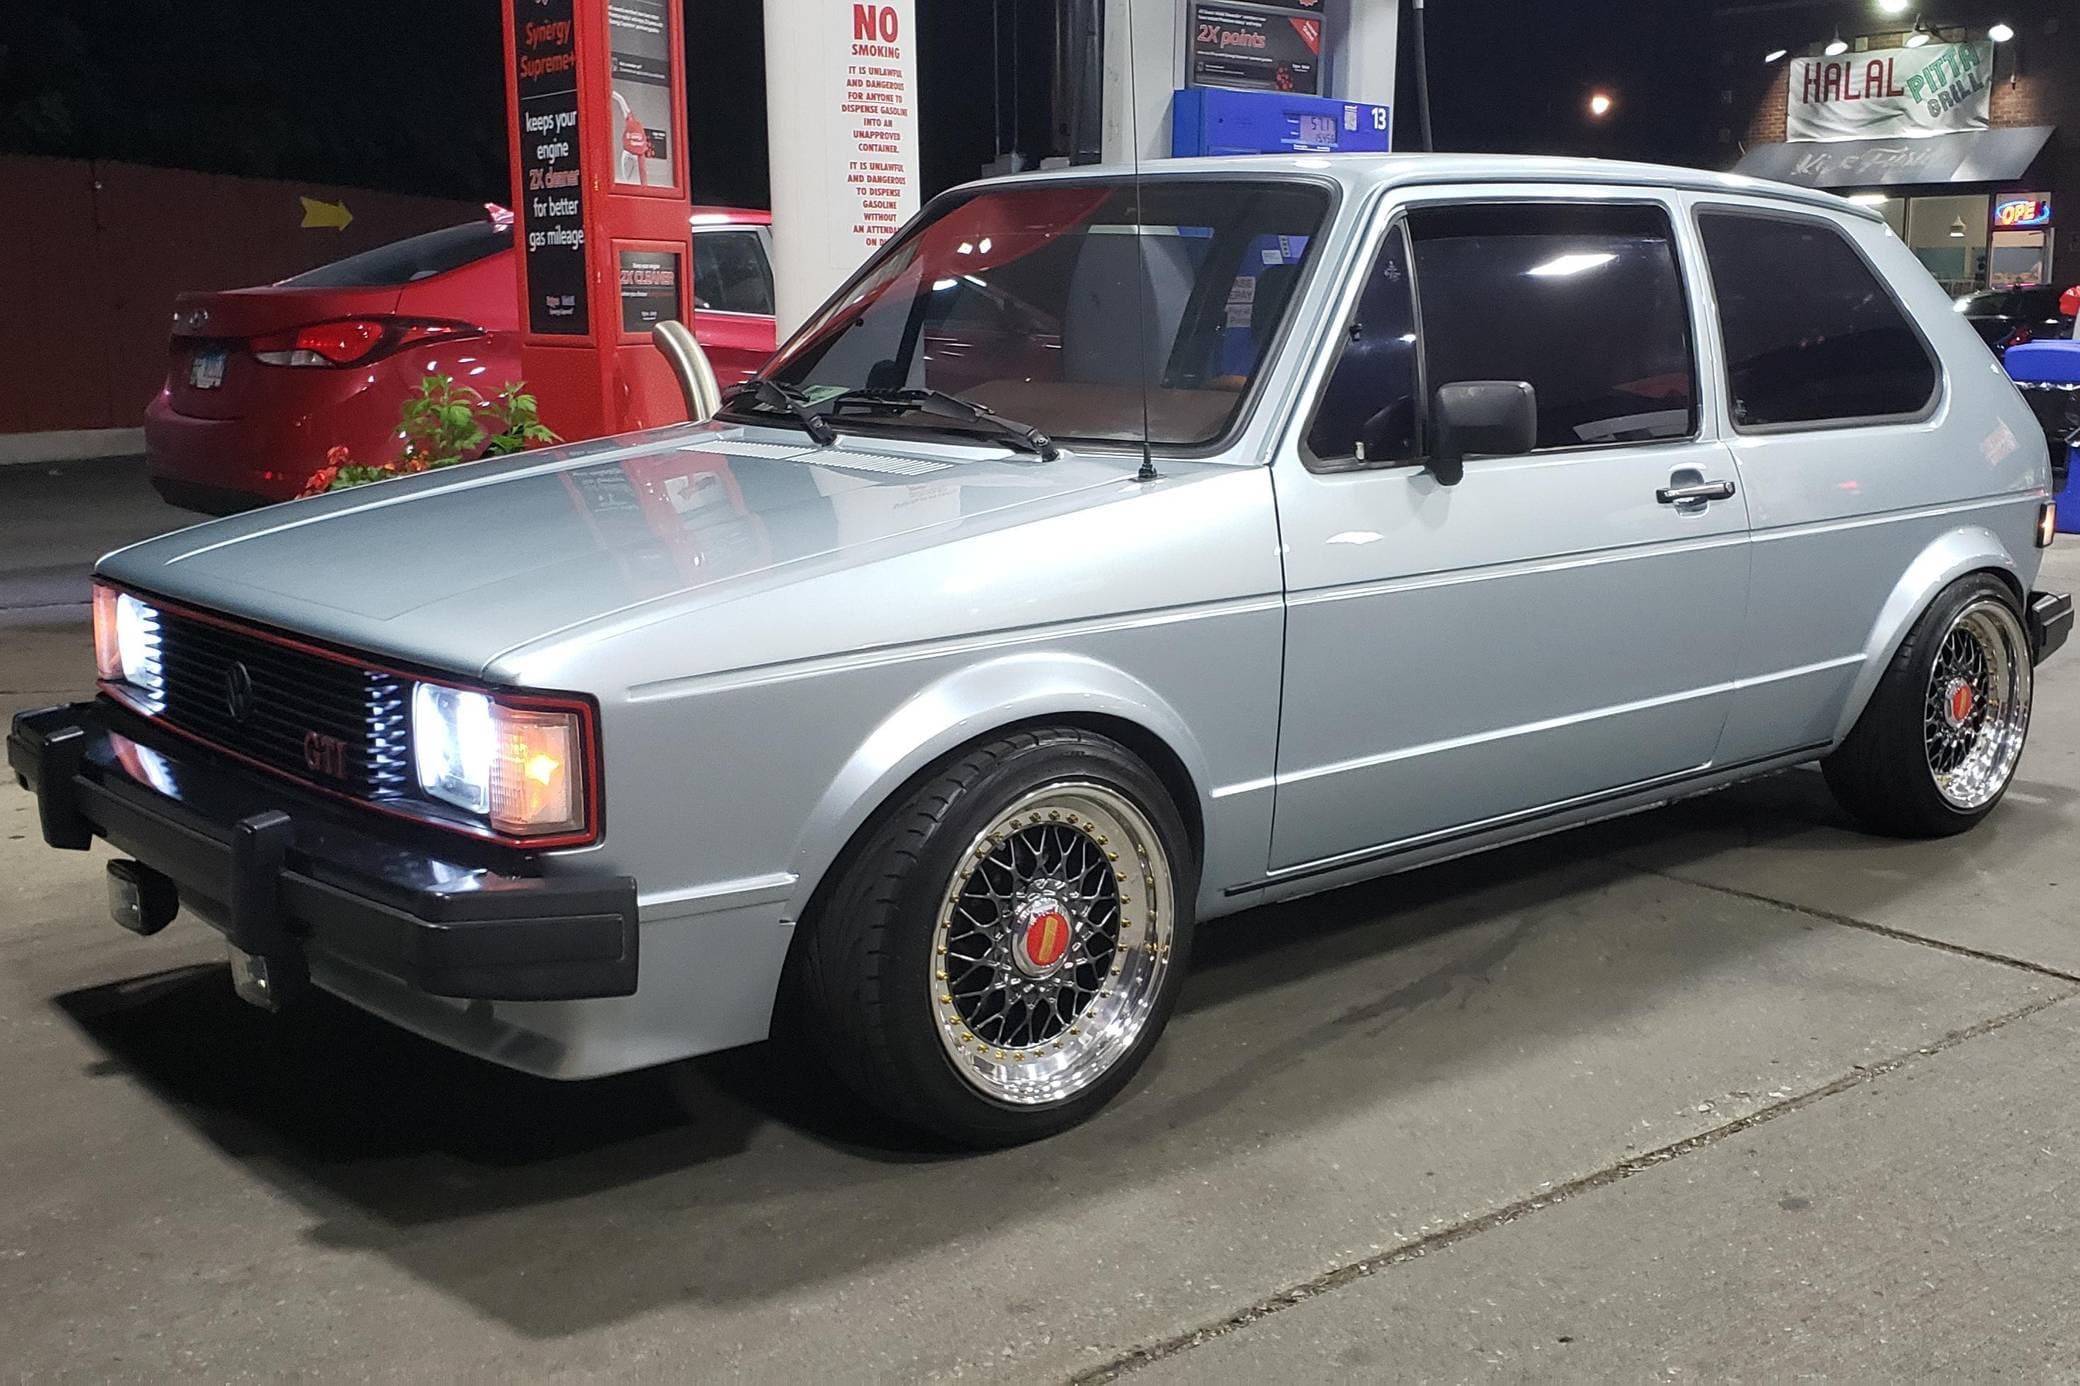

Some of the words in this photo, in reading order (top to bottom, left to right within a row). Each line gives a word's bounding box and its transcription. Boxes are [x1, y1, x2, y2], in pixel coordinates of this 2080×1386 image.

[853, 4, 898, 43] NO
[526, 20, 571, 49] Synergy
[1197, 24, 1220, 43] 2X
[1220, 28, 1267, 48] points
[851, 44, 900, 59] SMOKING
[520, 52, 575, 82] Supreme+
[849, 66, 856, 74] IT
[859, 66, 866, 75] IS
[868, 67, 903, 78] UNLAWFUL
[1906, 41, 1981, 104] PITTA
[847, 79, 863, 88] AND
[866, 80, 904, 91] DANGEROUS
[1803, 57, 1904, 104] HALAL
[848, 91, 863, 100] FOR
[866, 93, 894, 103] ANYONE
[895, 94, 903, 104] TO
[1927, 72, 1985, 118] GRILL
[841, 104, 879, 114] DISPENSE
[880, 106, 908, 117] GASOLINE
[1371, 107, 1387, 130] 13
[526, 112, 554, 136] keeps
[555, 110, 578, 134] your
[864, 118, 881, 127] INTO
[883, 119, 893, 128] AN
[853, 130, 900, 141] UNAPPROVED
[537, 138, 569, 164] engine
[850, 162, 857, 170] IT
[860, 162, 867, 170] IS
[869, 163, 904, 173] UNLAWFUL
[529, 168, 545, 190] 2X
[847, 175, 865, 184] AND
[867, 175, 906, 185] DANGEROUS
[856, 187, 867, 196] TO
[869, 187, 901, 197] DISPENSE
[533, 197, 548, 217] for
[548, 196, 579, 217] better
[863, 200, 897, 209] GASOLINE
[864, 213, 897, 222] WITHOUT
[529, 232, 546, 252] gas
[547, 225, 585, 250] mileage
[853, 225, 864, 234] AN
[866, 238, 877, 247] ON
[304, 730, 348, 780] GTI
